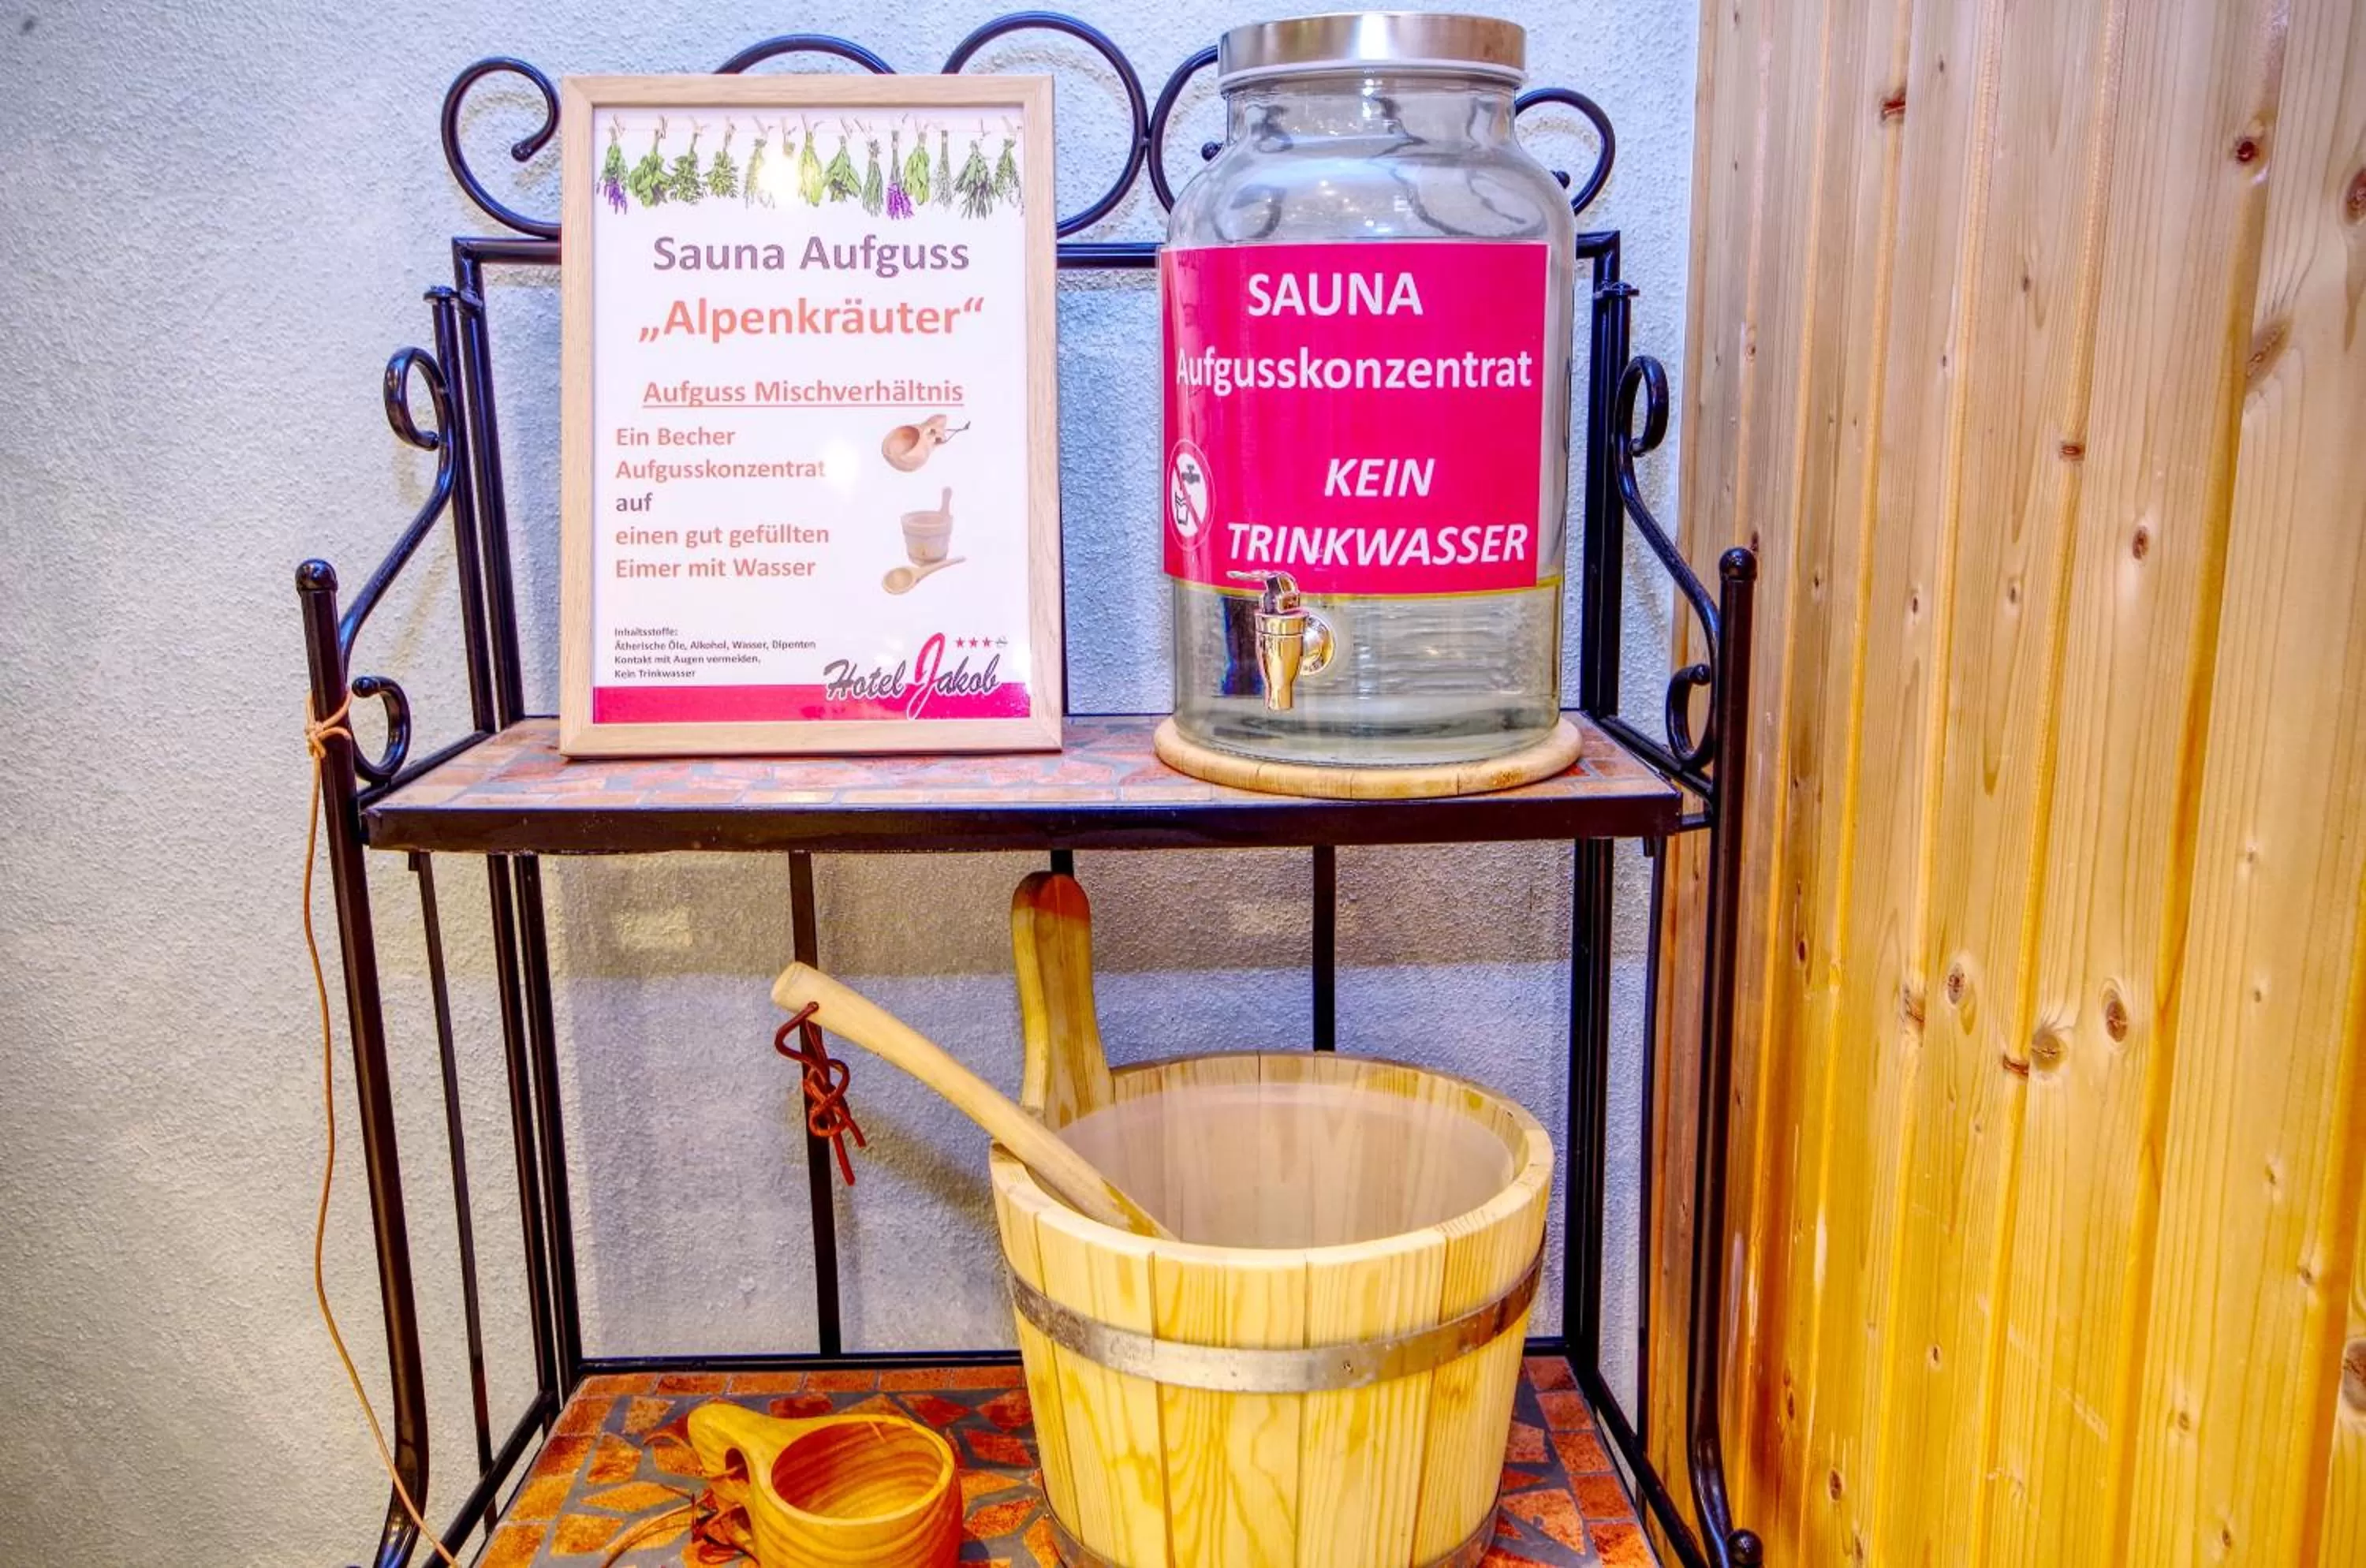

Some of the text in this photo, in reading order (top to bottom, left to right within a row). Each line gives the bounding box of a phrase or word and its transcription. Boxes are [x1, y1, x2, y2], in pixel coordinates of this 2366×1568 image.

[653, 234, 970, 278] Sauna Aufguss
[1248, 272, 1424, 317] SAUNA
[1177, 347, 1532, 396] Aufgusskonzentrat
[643, 380, 964, 406] Aufguss Mischverhältnis
[616, 427, 736, 446] Ein Becher
[616, 460, 827, 483] Aufgusskonzentrat
[1324, 458, 1435, 498] KEIN
[616, 492, 654, 512] auf
[616, 524, 829, 548] einen gut gefüllten
[1227, 523, 1528, 567] TRINKWASSER
[616, 558, 816, 578] Eimer mit Wasser
[614, 655, 651, 664] Kontakt
[655, 655, 670, 664] mit
[674, 655, 703, 665] Augen
[614, 669, 696, 678] Kein Trinkwasser
[823, 633, 1000, 719] Hotel Jakob
